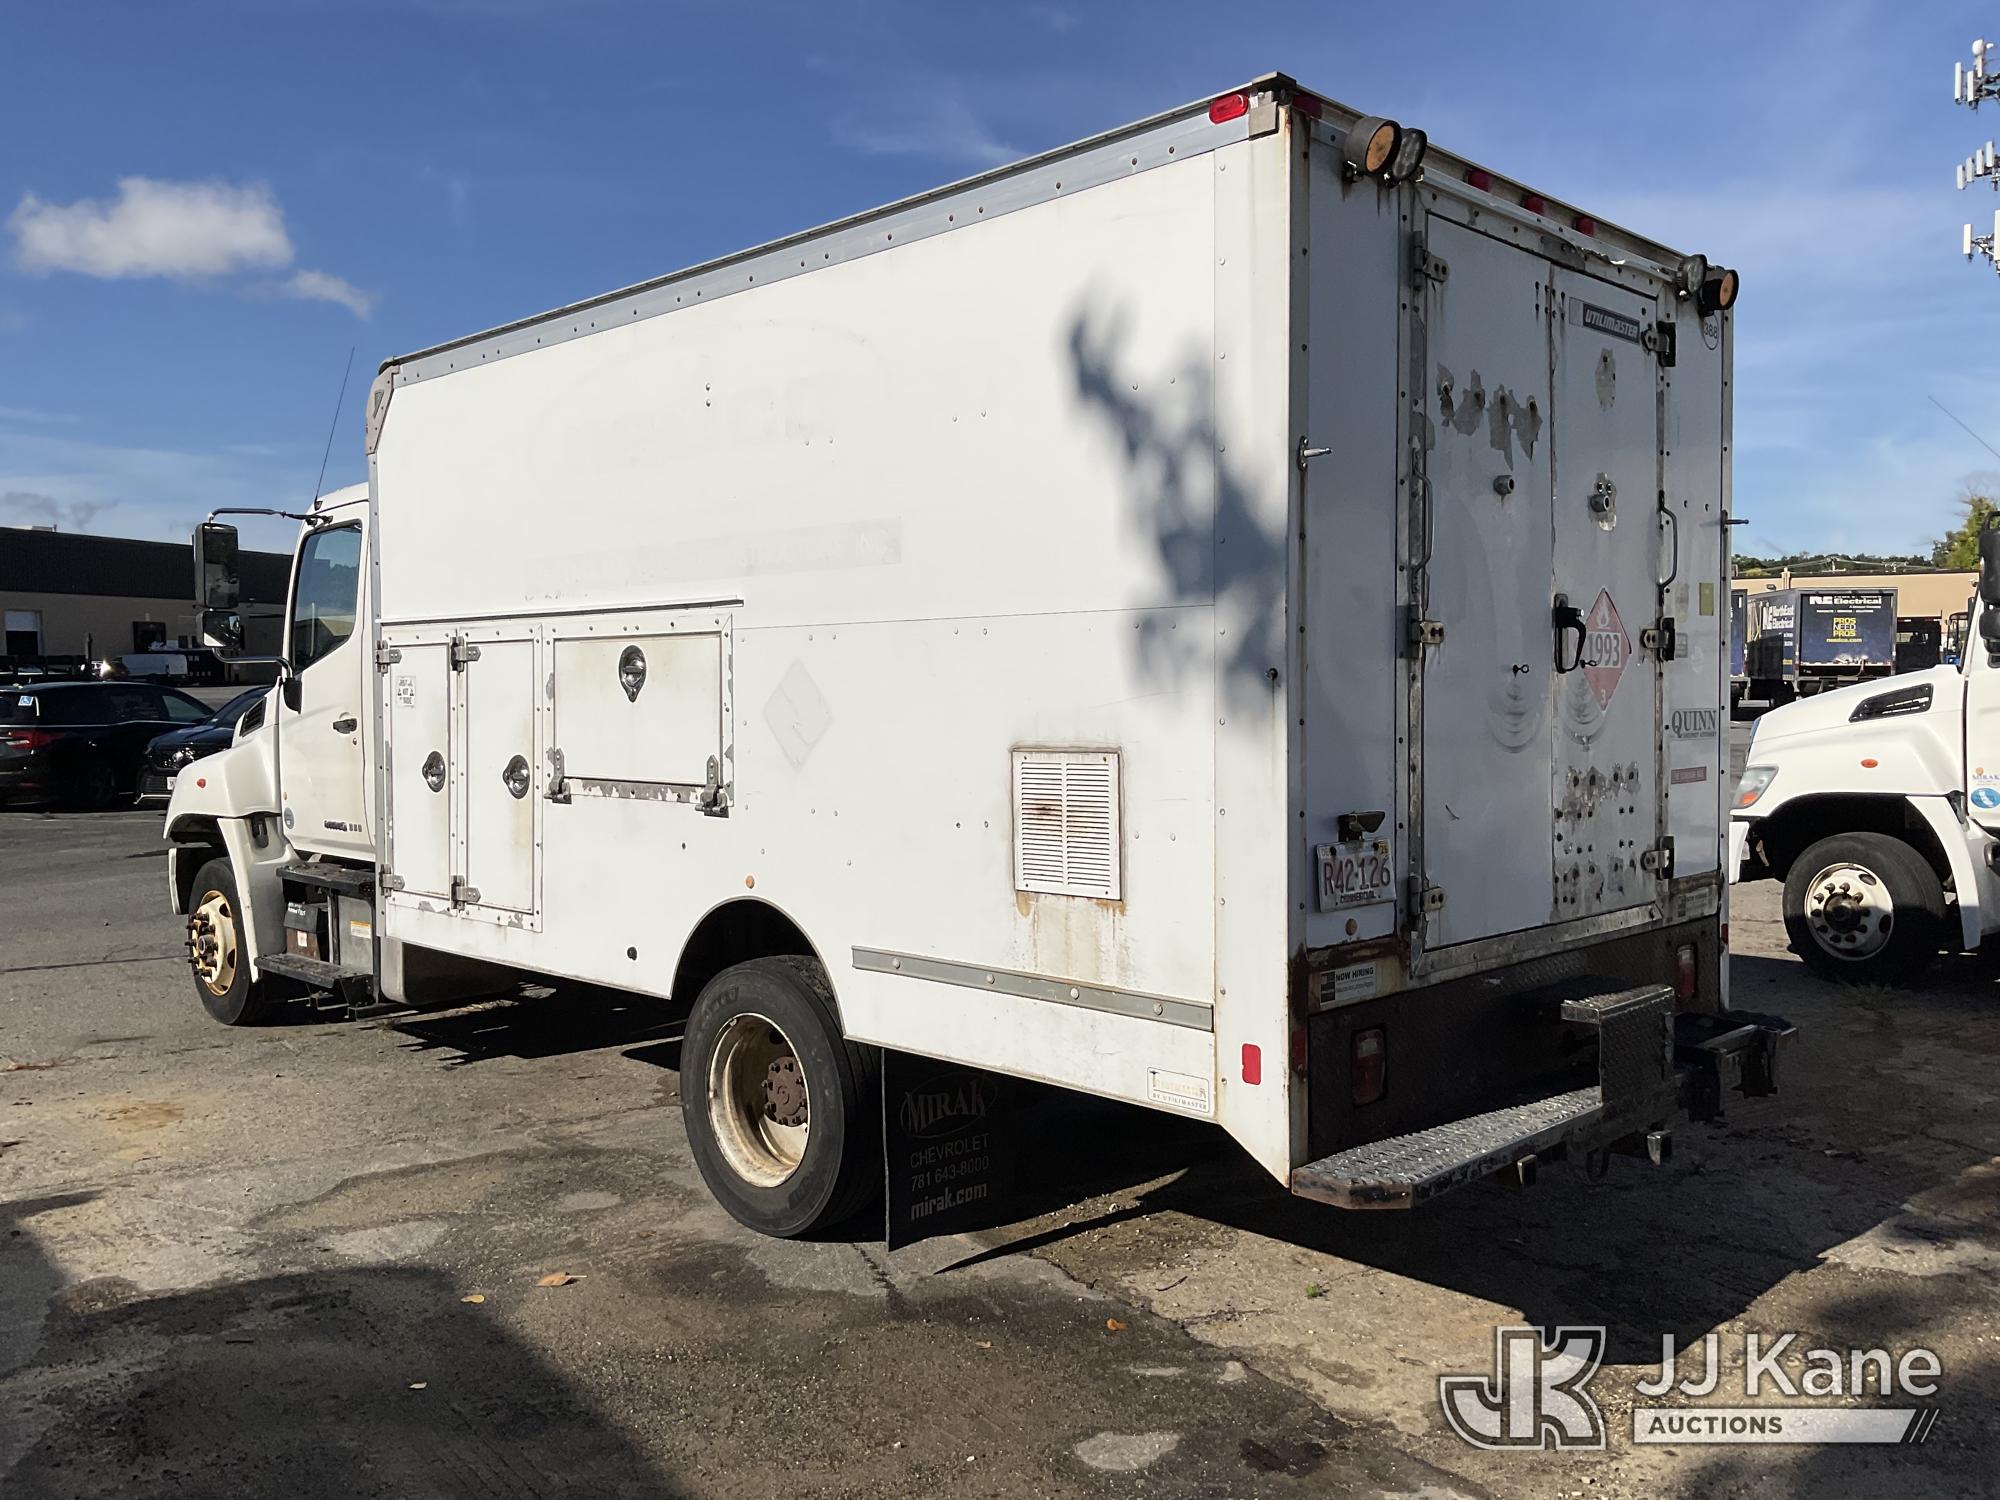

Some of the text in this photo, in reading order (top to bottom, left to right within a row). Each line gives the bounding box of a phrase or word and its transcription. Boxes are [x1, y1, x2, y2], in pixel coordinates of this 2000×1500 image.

[1587, 633, 1620, 667] 1993
[1600, 688, 1606, 703] 3
[1672, 710, 1717, 738] QUINN
[1336, 971, 1350, 982] NOW
[904, 1079, 986, 1133] MIRAK
[910, 1133, 989, 1168] CHEVROLET
[911, 1155, 989, 1192] 781 643-8000
[911, 1183, 988, 1220] mirak.com
